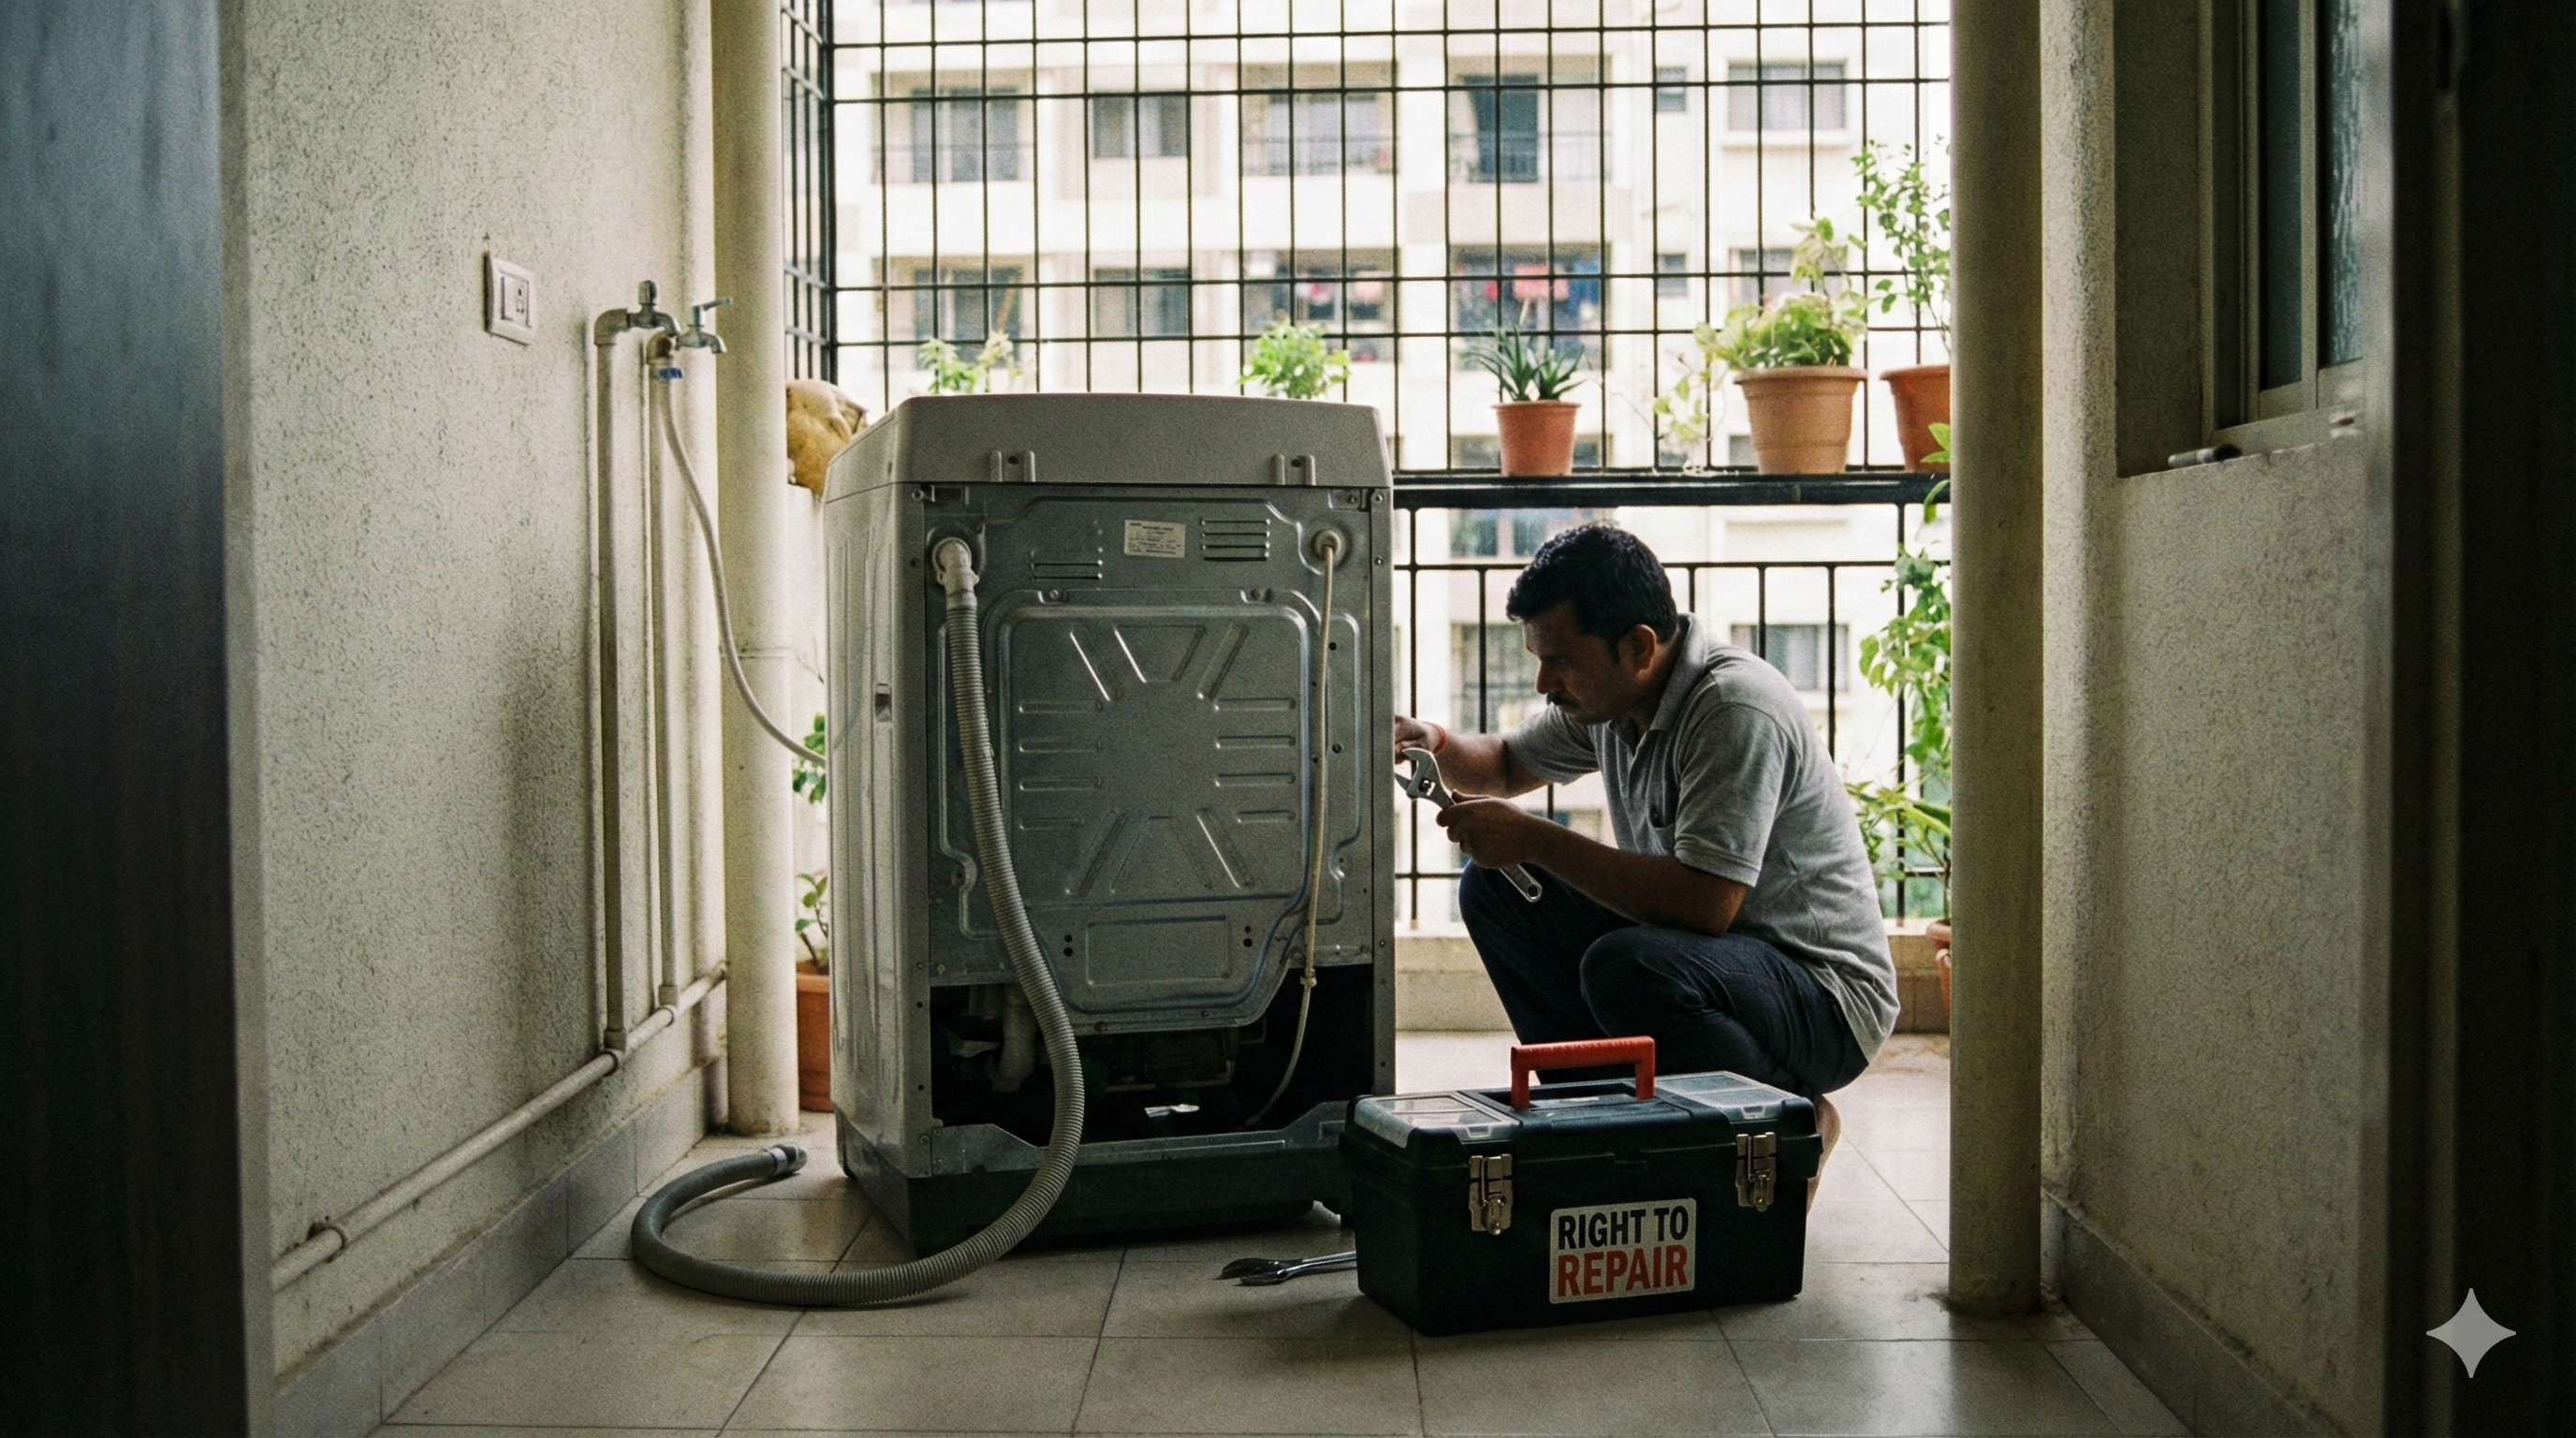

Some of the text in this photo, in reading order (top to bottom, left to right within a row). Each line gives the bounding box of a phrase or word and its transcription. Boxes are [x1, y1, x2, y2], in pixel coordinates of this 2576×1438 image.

[1559, 1206, 1690, 1250] RIGHT TO
[1558, 1244, 1689, 1298] REPAIR
